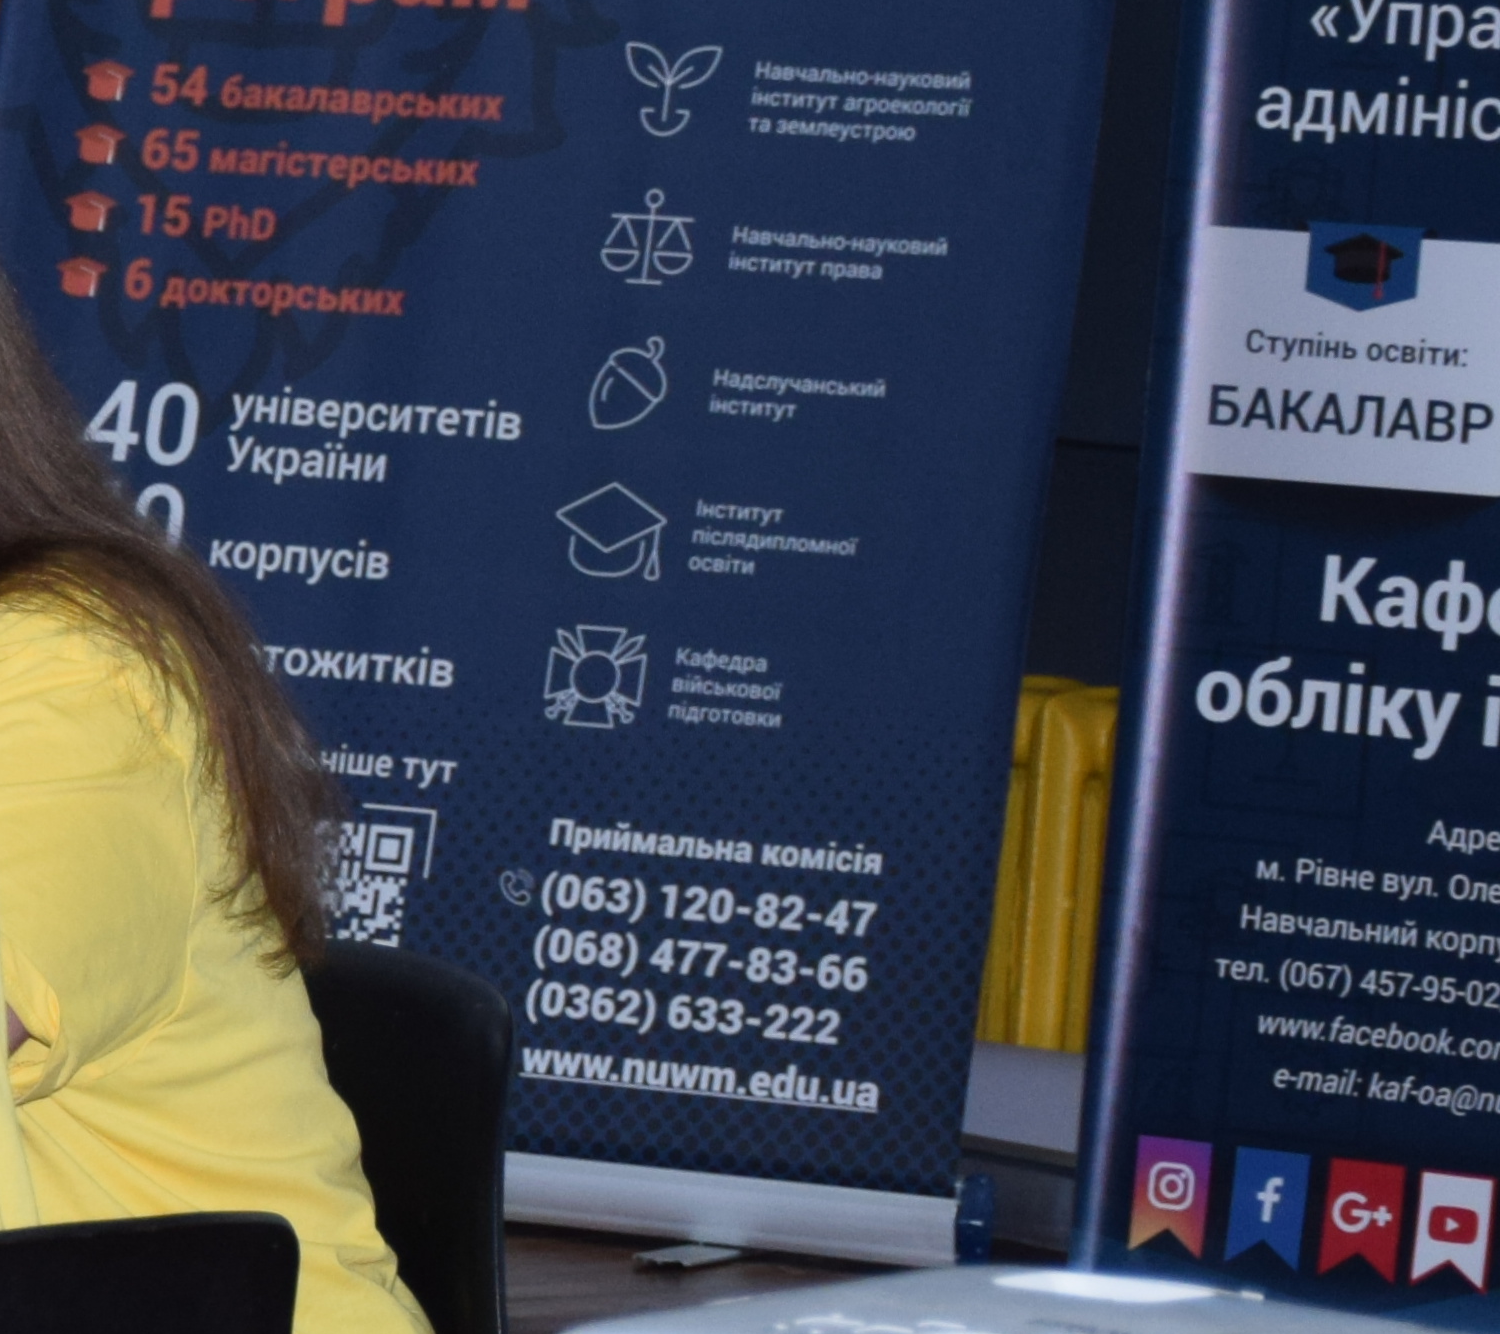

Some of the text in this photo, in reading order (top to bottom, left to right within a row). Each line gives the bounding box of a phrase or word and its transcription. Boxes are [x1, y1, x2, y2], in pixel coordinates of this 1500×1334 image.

[150, 63, 503, 123] 54 бакалаврських
[755, 61, 971, 89] Навчально-науковий
[751, 87, 972, 118] інститут агроекології
[748, 117, 916, 142] та землеустрою
[141, 128, 479, 186] 65 магістерських
[136, 194, 276, 241] 15 PhD
[731, 226, 948, 256] Навчально-науковий
[123, 258, 404, 316] 6 докторських
[729, 253, 883, 280] інститут права
[1245, 328, 1468, 367] Ступінь освіти:
[713, 369, 885, 398] Надслучанський
[84, 378, 522, 466] 40 університетів
[709, 395, 795, 421] інститут
[1207, 384, 1494, 444] БАКАЛАВР
[226, 436, 388, 484] України
[696, 500, 783, 525] Інститут
[210, 538, 389, 584] корпусів
[692, 527, 858, 556] післядипломної
[688, 555, 755, 574] освіти
[1320, 554, 1500, 651] Каф
[675, 647, 767, 675] Кафедра
[672, 677, 782, 700] військової
[1196, 655, 1462, 761] обліку
[668, 703, 781, 727] підготовки
[402, 757, 458, 788] тут
[549, 818, 883, 874] Приймальна комісія
[1256, 860, 1285, 882] м.
[1295, 858, 1376, 891] Рівне
[1382, 873, 1439, 901] вул.
[540, 872, 878, 937] (063) 120-82-47
[1240, 904, 1418, 947] Навчальний
[533, 924, 868, 993] (068) 477-83-66
[1215, 958, 1500, 1008] тел. (067) 457-95-02
[525, 979, 841, 1045] (0362) 633-222
[521, 1046, 880, 1109] www.nuwm.edu.ua
[1273, 1067, 1359, 1098] e-mail:
